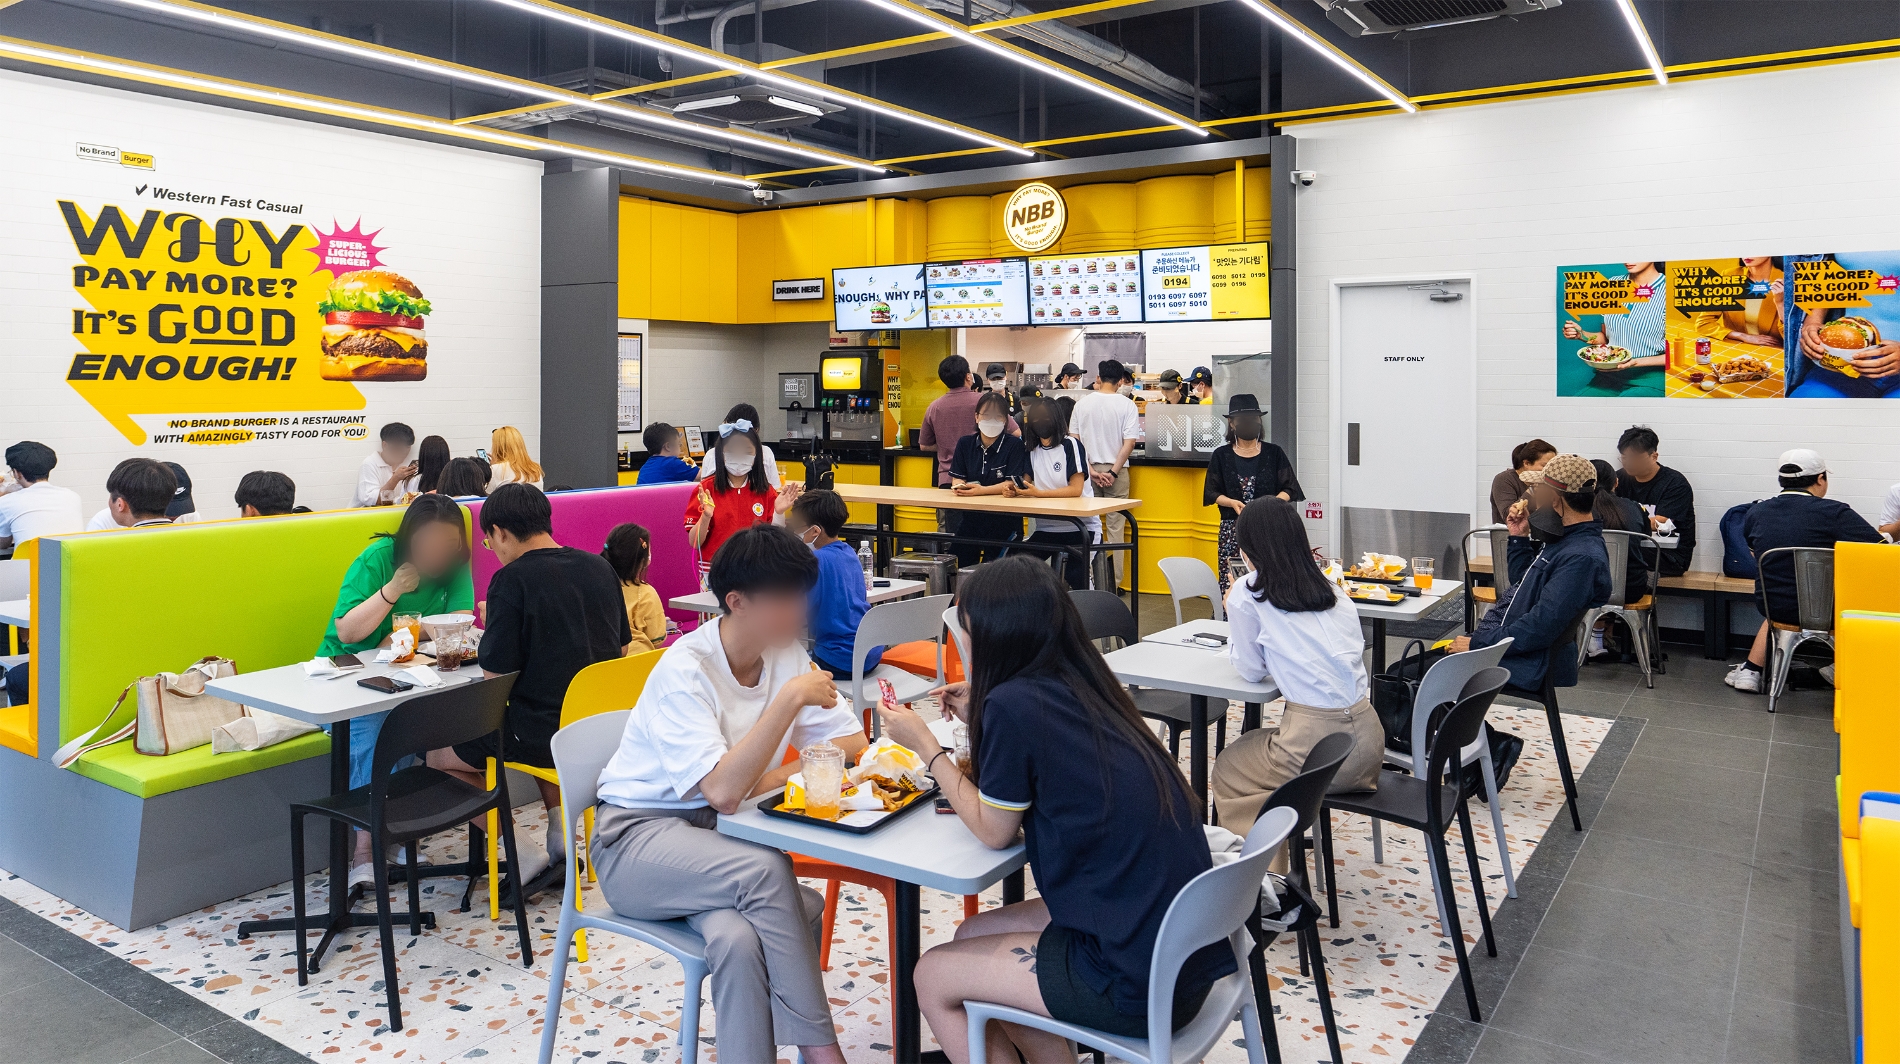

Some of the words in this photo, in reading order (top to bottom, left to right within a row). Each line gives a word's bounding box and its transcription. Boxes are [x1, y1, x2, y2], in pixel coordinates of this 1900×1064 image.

[79, 146, 90, 154] No
[92, 148, 115, 157] Brand
[124, 154, 150, 164] Burger
[153, 187, 216, 205] Western
[220, 195, 252, 209] Fast
[256, 199, 303, 215] Casual
[1011, 200, 1055, 228] NBB
[57, 200, 304, 270] WHY
[329, 240, 366, 250] SUPER-
[327, 248, 368, 259] LICIOUS
[325, 256, 370, 267] BURGER!
[1155, 257, 1178, 265] 주문하신
[1792, 261, 1833, 271] WHY
[1152, 263, 1200, 274] 준비되었습니다
[1672, 267, 1710, 276] WHY
[1564, 271, 1598, 280] WHY
[1674, 277, 1698, 286] PAY
[1700, 275, 1747, 286] MORE?
[1794, 272, 1820, 281] PAY
[1824, 270, 1874, 280] MORE?
[73, 265, 156, 291] PAY
[165, 271, 297, 299] MORE?
[1164, 278, 1188, 286] 0194
[1565, 281, 1586, 289] PAY
[1590, 280, 1631, 288] MORE?
[1794, 283, 1822, 292] IT'S
[1826, 281, 1870, 291] GOOD
[776, 286, 800, 294] DRINK
[801, 285, 820, 293] HERE
[1565, 291, 1588, 300] IT'S
[1592, 290, 1628, 299] GOOD
[1674, 287, 1700, 297] IT'S
[1703, 286, 1743, 296] GOOD
[885, 290, 910, 301] WHY
[914, 290, 925, 300] PA
[1794, 293, 1862, 302] ENOUGH.
[1565, 300, 1622, 309] ENOUGH.
[1674, 297, 1736, 307] ENOUGH.
[72, 309, 136, 335] IT'S
[148, 303, 295, 347] GOOD
[66, 354, 297, 381] ENOUGH!
[170, 419, 188, 428] NO
[190, 418, 230, 428] BRAND
[233, 417, 277, 427] BURGER
[279, 417, 290, 426] IS
[292, 417, 299, 425] A
[301, 415, 366, 425] RESTAURANT
[154, 434, 184, 444] WITH
[187, 432, 253, 443] AMAZINGLY
[255, 431, 289, 440] TASTY
[291, 430, 318, 439] FOOD
[320, 429, 341, 438] FOR
[343, 428, 366, 437] YOU!
